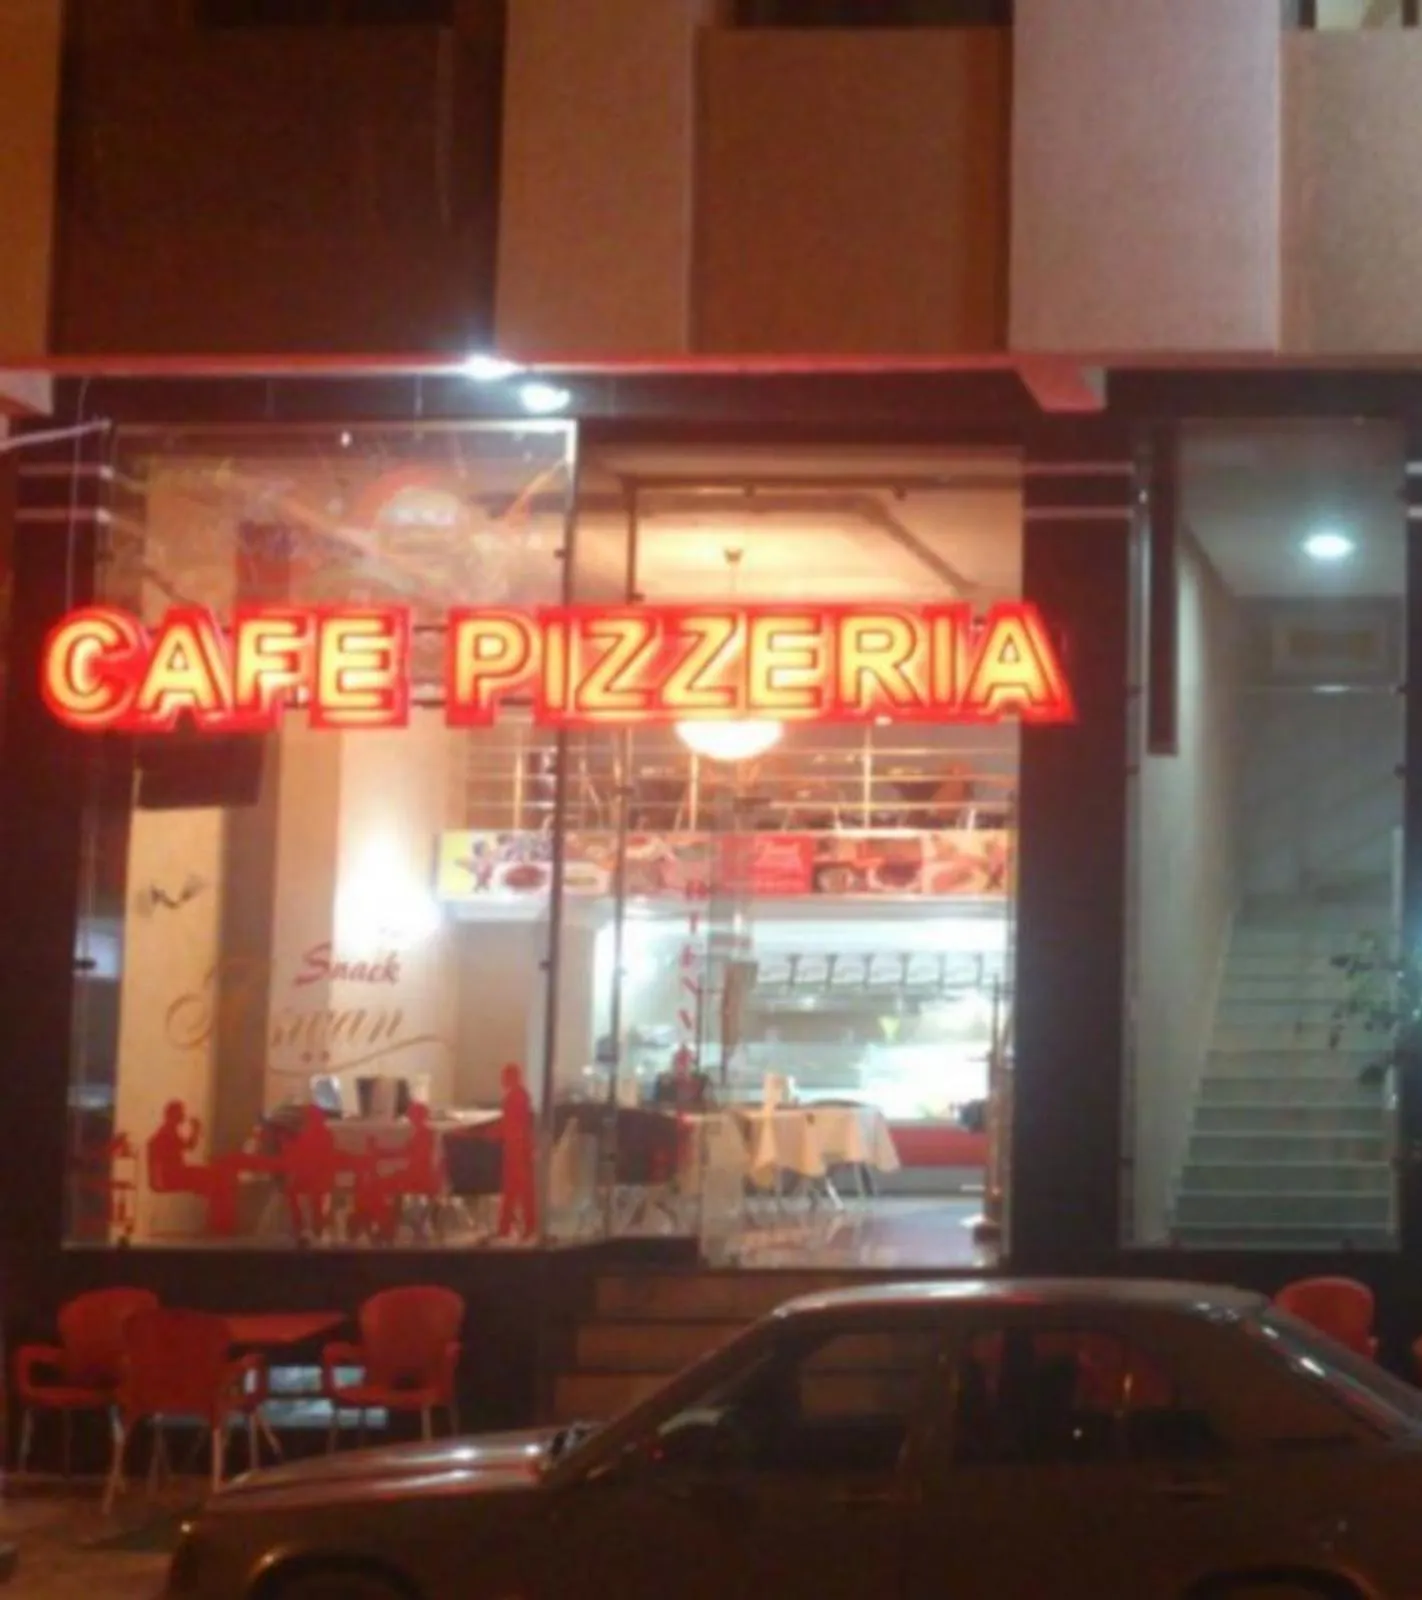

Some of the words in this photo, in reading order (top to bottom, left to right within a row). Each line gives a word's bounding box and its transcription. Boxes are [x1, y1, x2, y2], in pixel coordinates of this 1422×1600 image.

[43, 603, 409, 730] CAFE
[446, 602, 1077, 727] PIZZERIA
[294, 941, 401, 986] Snack
